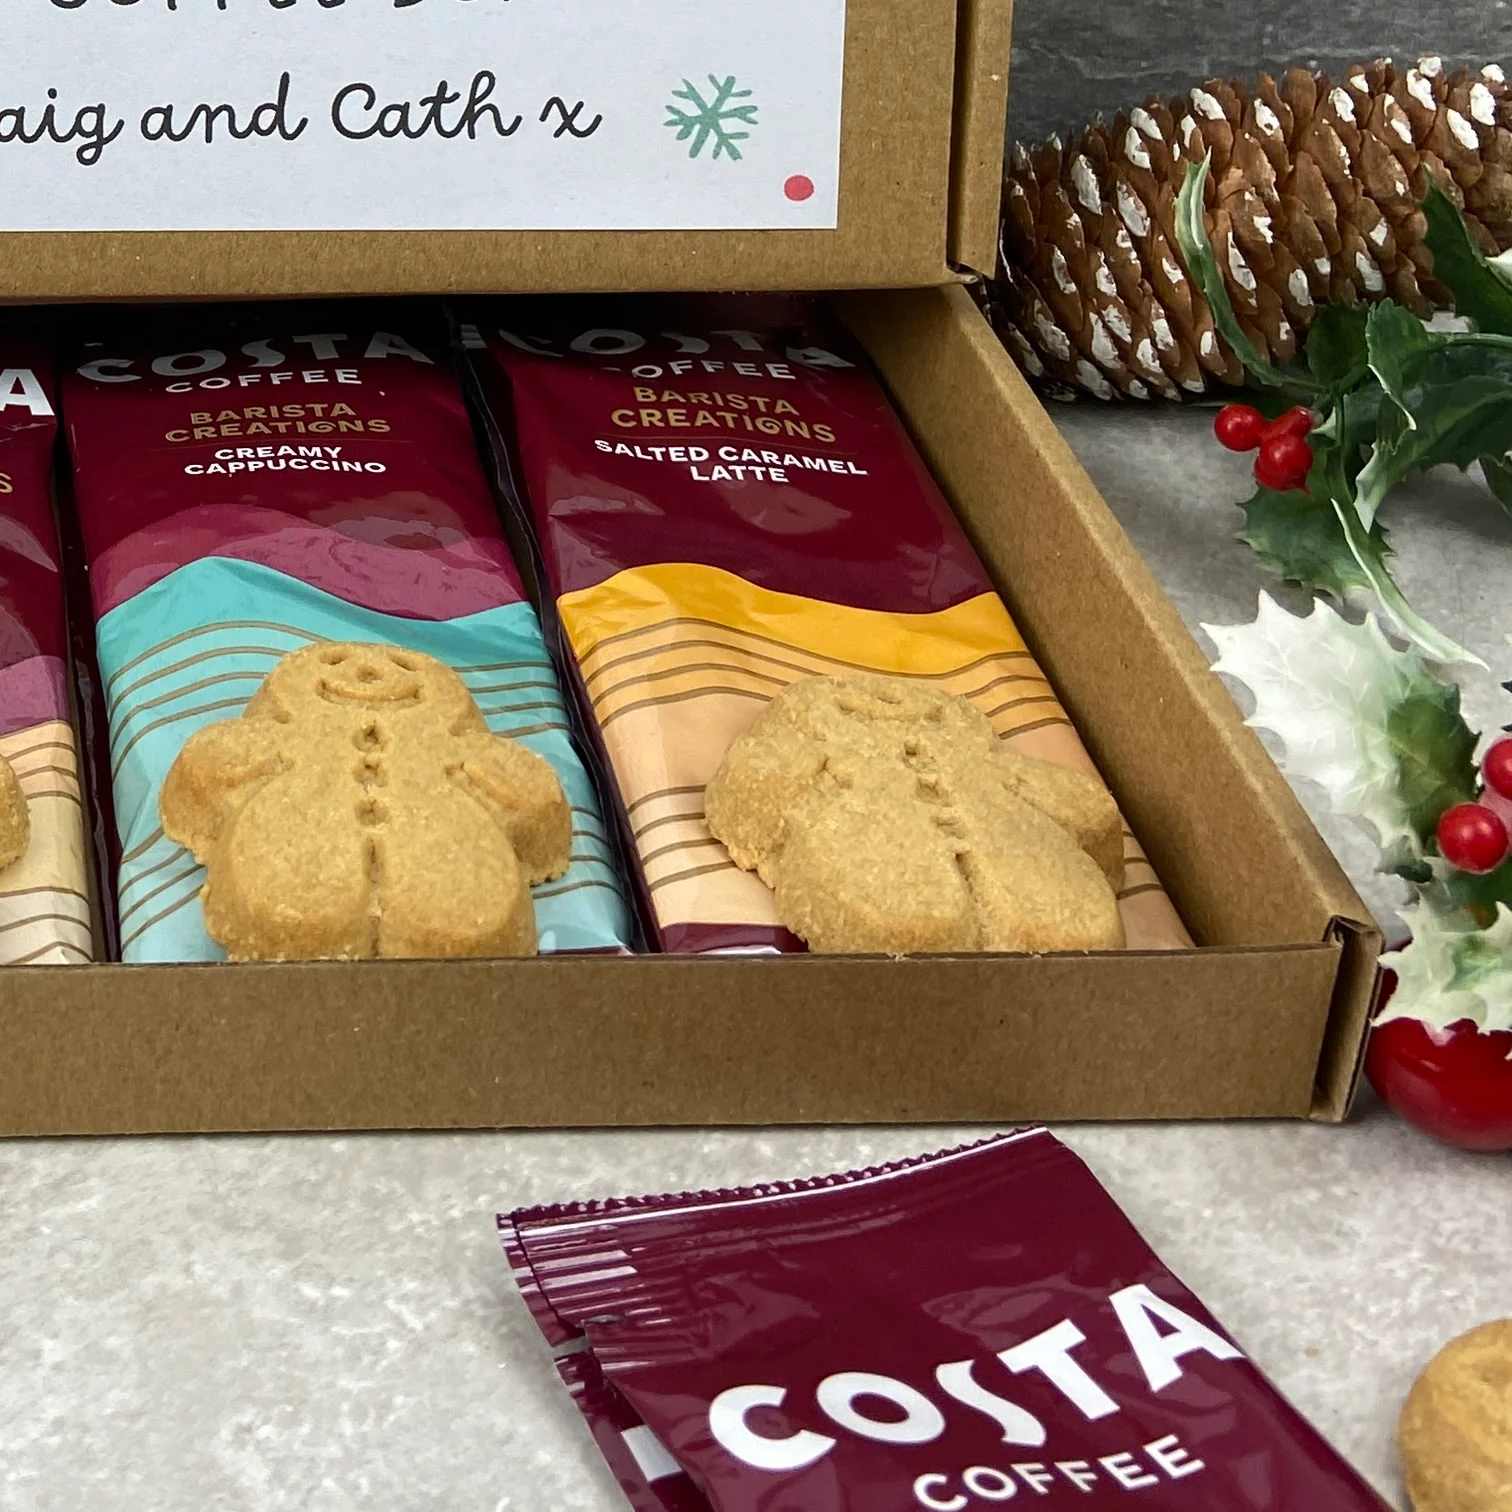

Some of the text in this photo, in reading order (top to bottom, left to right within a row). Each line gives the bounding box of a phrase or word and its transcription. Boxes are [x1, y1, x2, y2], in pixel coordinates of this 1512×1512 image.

[140, 71, 309, 144] and
[331, 70, 523, 140] Cath
[538, 96, 603, 139] x
[77, 331, 436, 383] COSTA
[600, 359, 797, 381] OFFEE
[165, 368, 363, 393] COFFEE
[189, 402, 357, 426] BARISTA
[632, 386, 800, 417] BARISTA
[165, 418, 392, 443] CREATIONS
[609, 407, 837, 444] CREATIONS
[183, 457, 388, 475] CAPPUCCINO
[213, 444, 343, 461] CREAMY
[593, 439, 868, 477] SALTED CARAMEL
[689, 464, 790, 484] LATTE
[708, 1283, 1248, 1471] COSTA
[913, 1434, 1204, 1511] COFFEE
